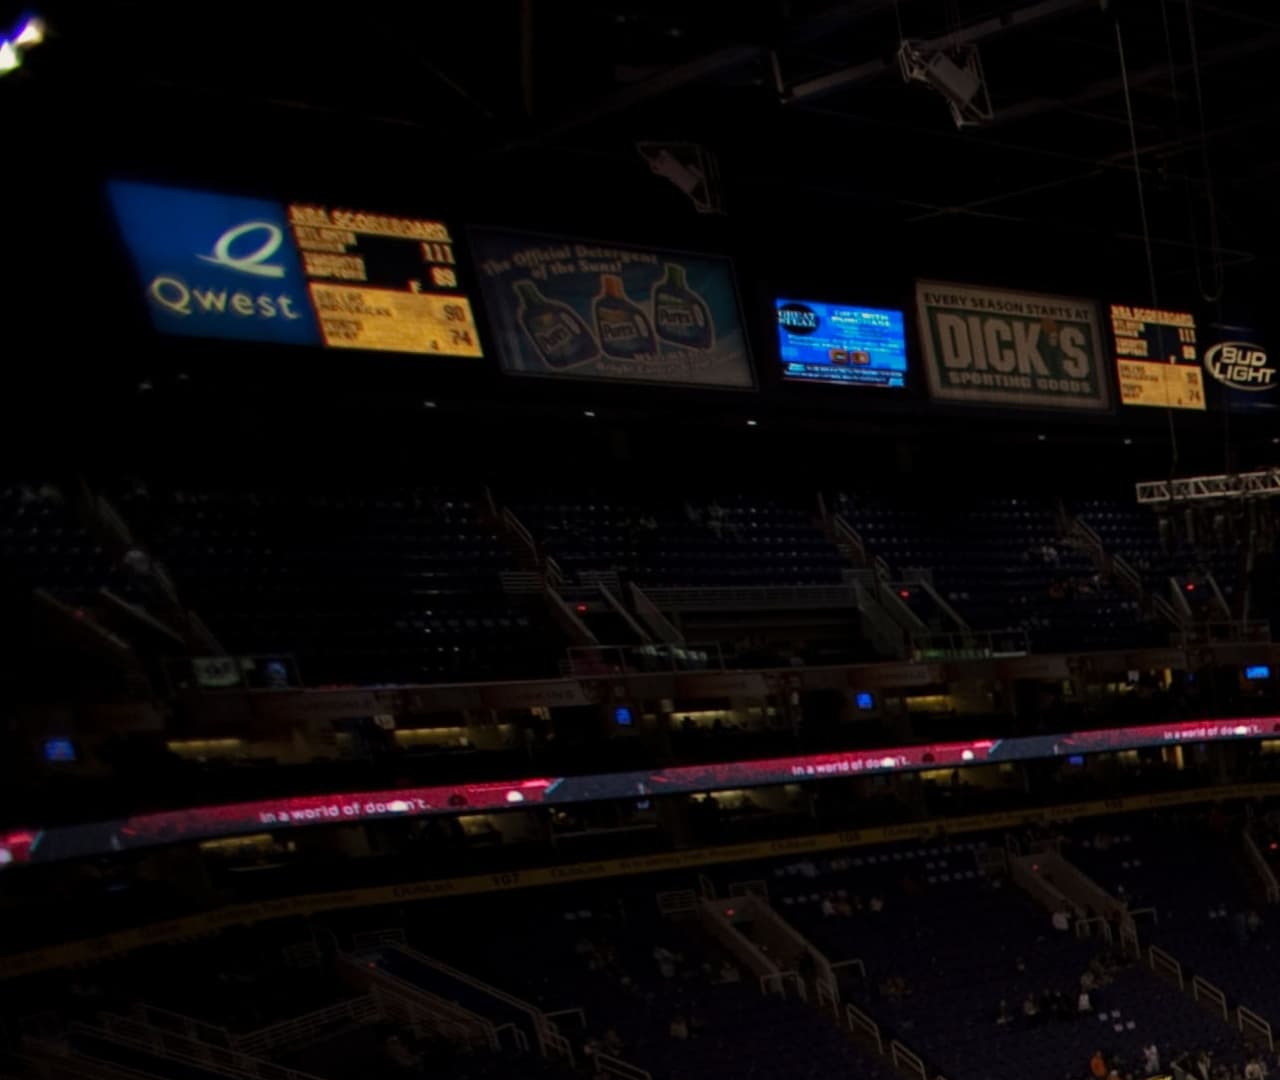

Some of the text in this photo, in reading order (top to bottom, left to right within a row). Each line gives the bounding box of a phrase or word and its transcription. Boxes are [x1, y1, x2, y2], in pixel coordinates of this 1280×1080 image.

[421, 241, 456, 265] 111
[512, 242, 571, 265] Official
[151, 276, 302, 319] Qwest
[923, 292, 1090, 321] EVERY SEASON STARTS AT
[450, 329, 473, 347] 74
[935, 312, 1091, 380] DICK'S
[1221, 346, 1268, 367] BUD
[947, 370, 1092, 394] SPORTING GOODS
[1214, 361, 1278, 385] LIGHT
[865, 755, 911, 769] don't.
[260, 811, 277, 824] In
[292, 804, 340, 820] world
[343, 801, 361, 815] of
[365, 797, 432, 813] don't.
